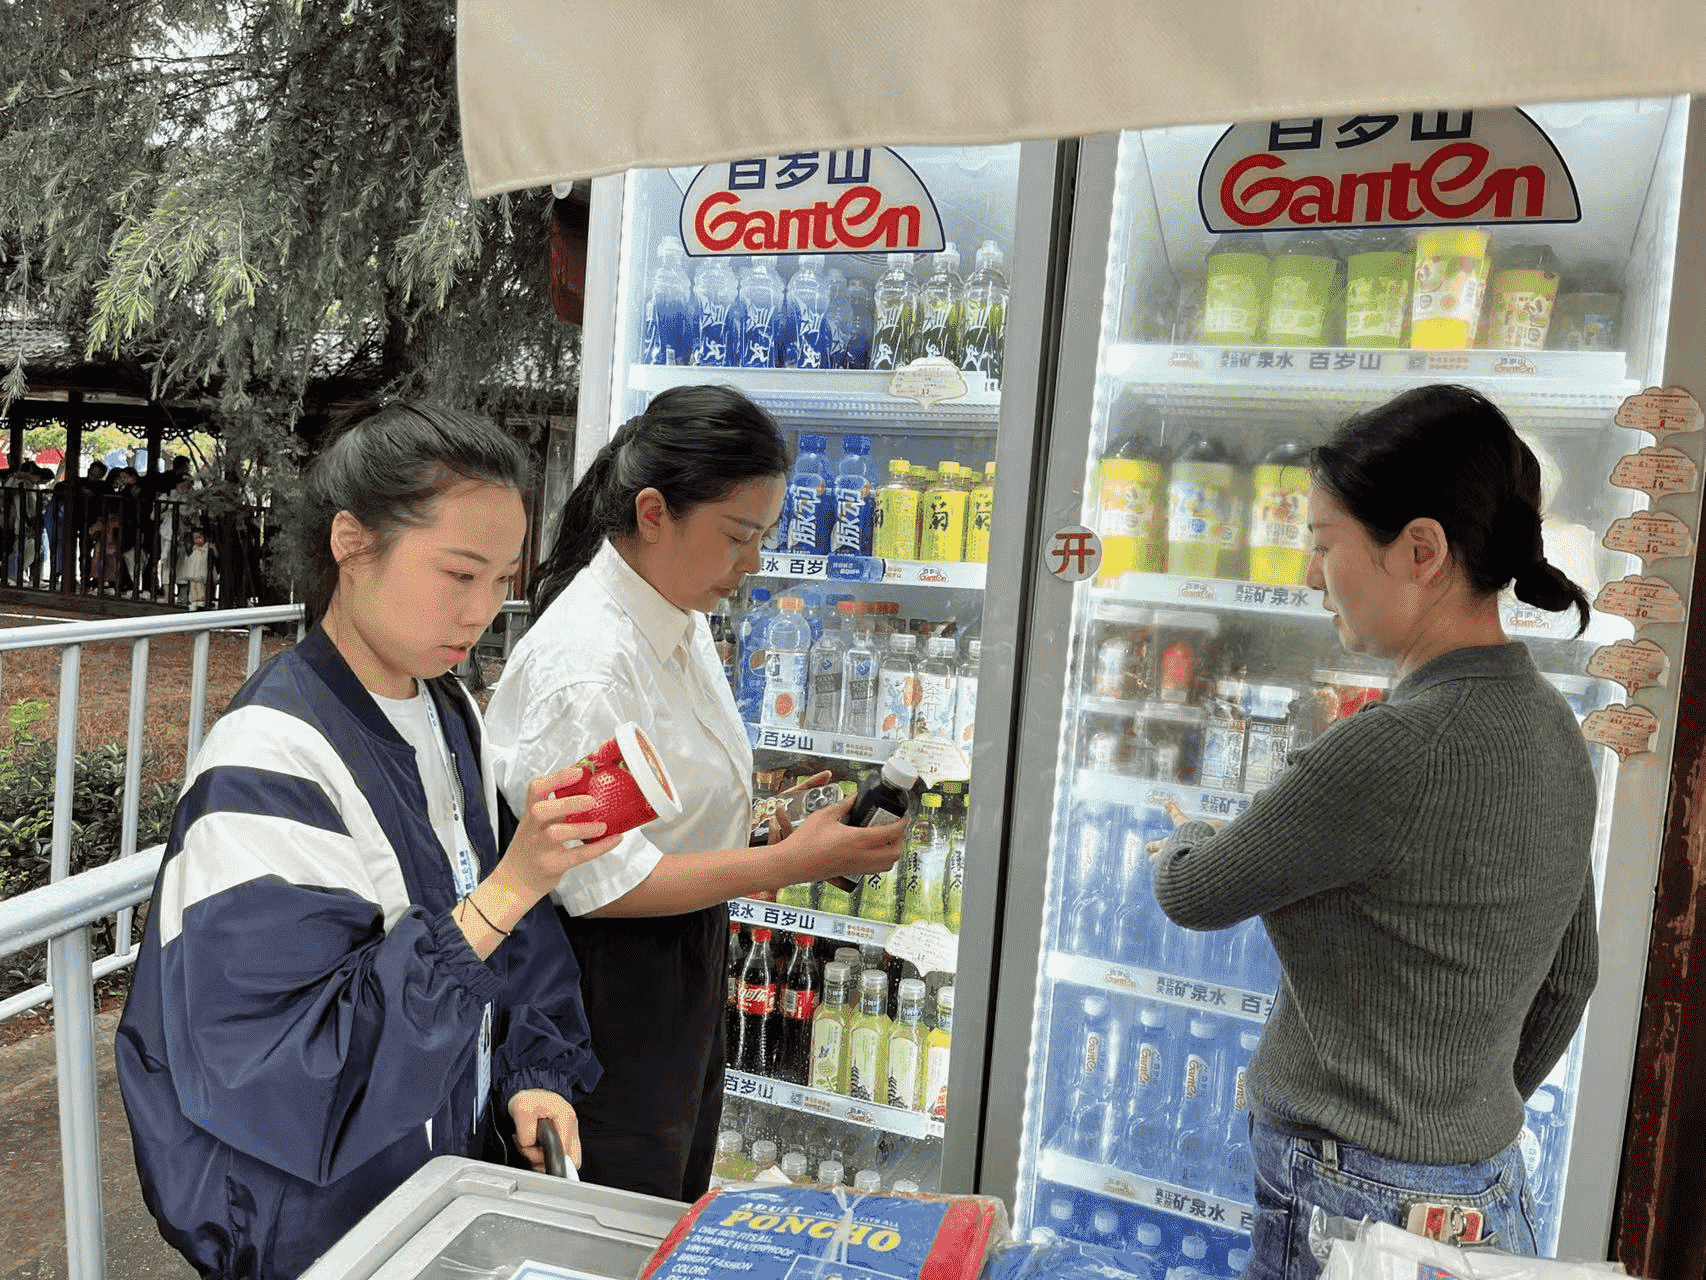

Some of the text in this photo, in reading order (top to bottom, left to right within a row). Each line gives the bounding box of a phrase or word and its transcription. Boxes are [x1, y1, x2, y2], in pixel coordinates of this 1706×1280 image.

[1220, 142, 1546, 227] Ganten
[694, 185, 921, 251] Ganten
[1309, 351, 1382, 371] 百岁山
[1051, 533, 1096, 575] 开
[1254, 585, 1309, 607] 矿泉水
[764, 731, 813, 751] 百岁山
[764, 907, 815, 930] 百岁山
[1174, 980, 1227, 1006] 矿泉水
[724, 1074, 774, 1100] 百岁山
[739, 1202, 804, 1214] ADULT
[1173, 1193, 1226, 1222] 矿泉水
[698, 1226, 720, 1236] ONE
[691, 1234, 797, 1257] DURABLE WATERPROOF
[671, 1263, 711, 1276] COLORS
[677, 1253, 754, 1271] BRIGHT FASHION
